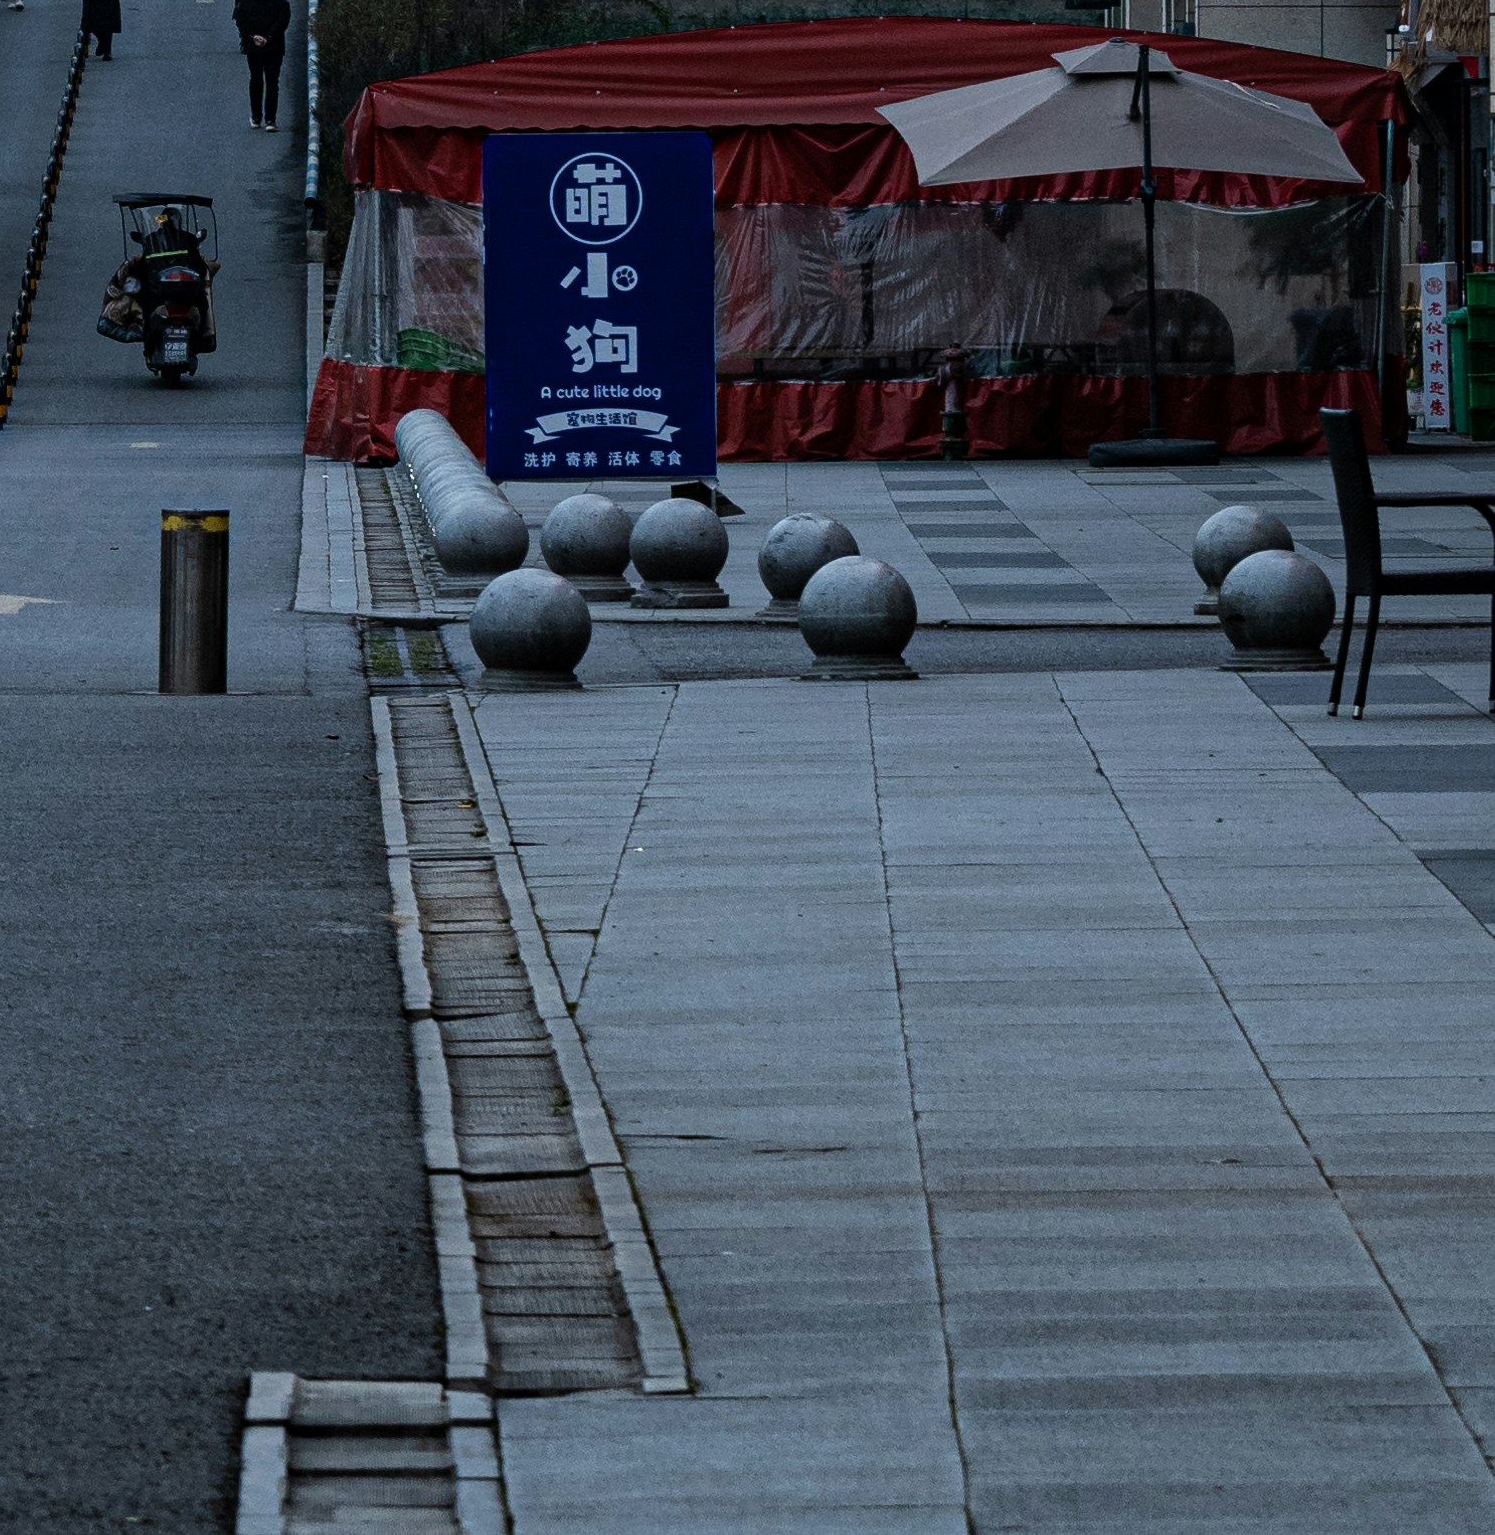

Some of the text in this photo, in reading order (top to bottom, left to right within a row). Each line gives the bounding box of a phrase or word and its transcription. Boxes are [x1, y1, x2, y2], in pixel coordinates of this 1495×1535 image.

[561, 162, 638, 374] 萌小狗
[1424, 301, 1446, 417] 老伙计欢迎您
[540, 384, 662, 401] A cute little dog
[566, 411, 638, 427] 宠物生活馆
[523, 449, 682, 468] 洗护 寄养 活体 零食
